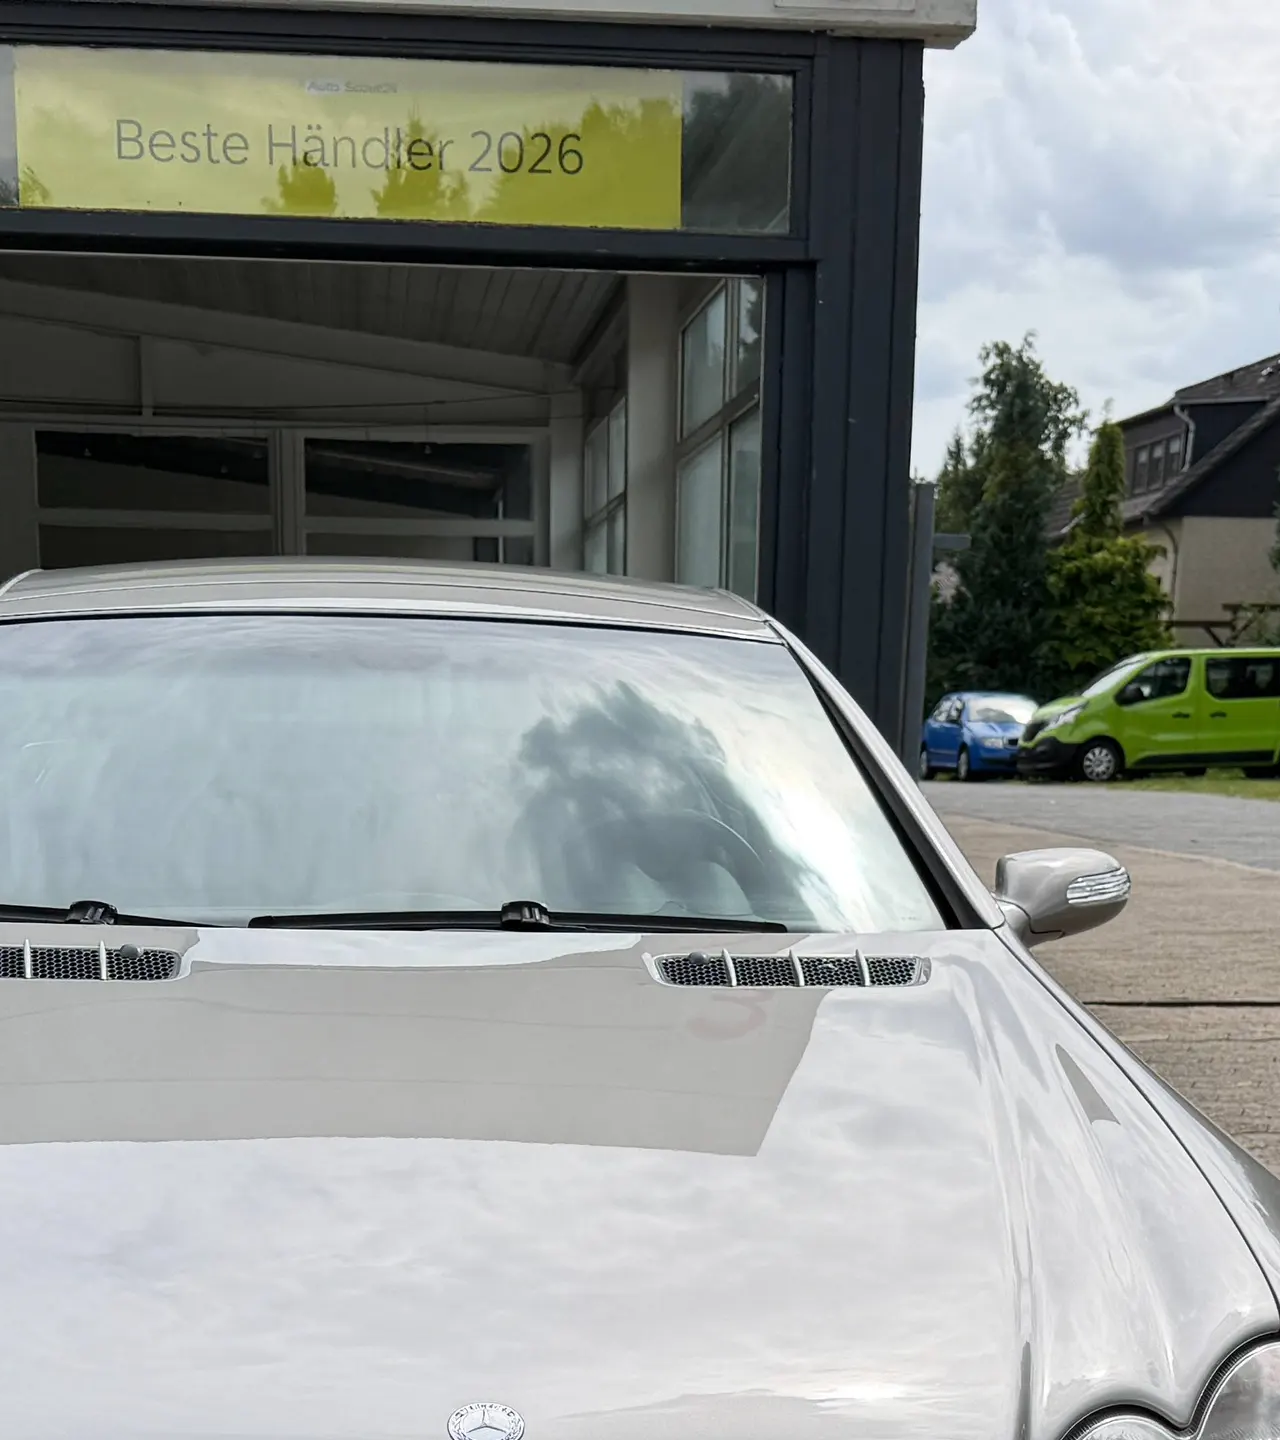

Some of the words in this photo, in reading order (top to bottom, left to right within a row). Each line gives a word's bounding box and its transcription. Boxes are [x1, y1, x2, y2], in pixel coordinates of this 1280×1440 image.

[115, 119, 249, 165] Beste
[268, 123, 456, 171] Händler
[468, 130, 584, 175] 2026
